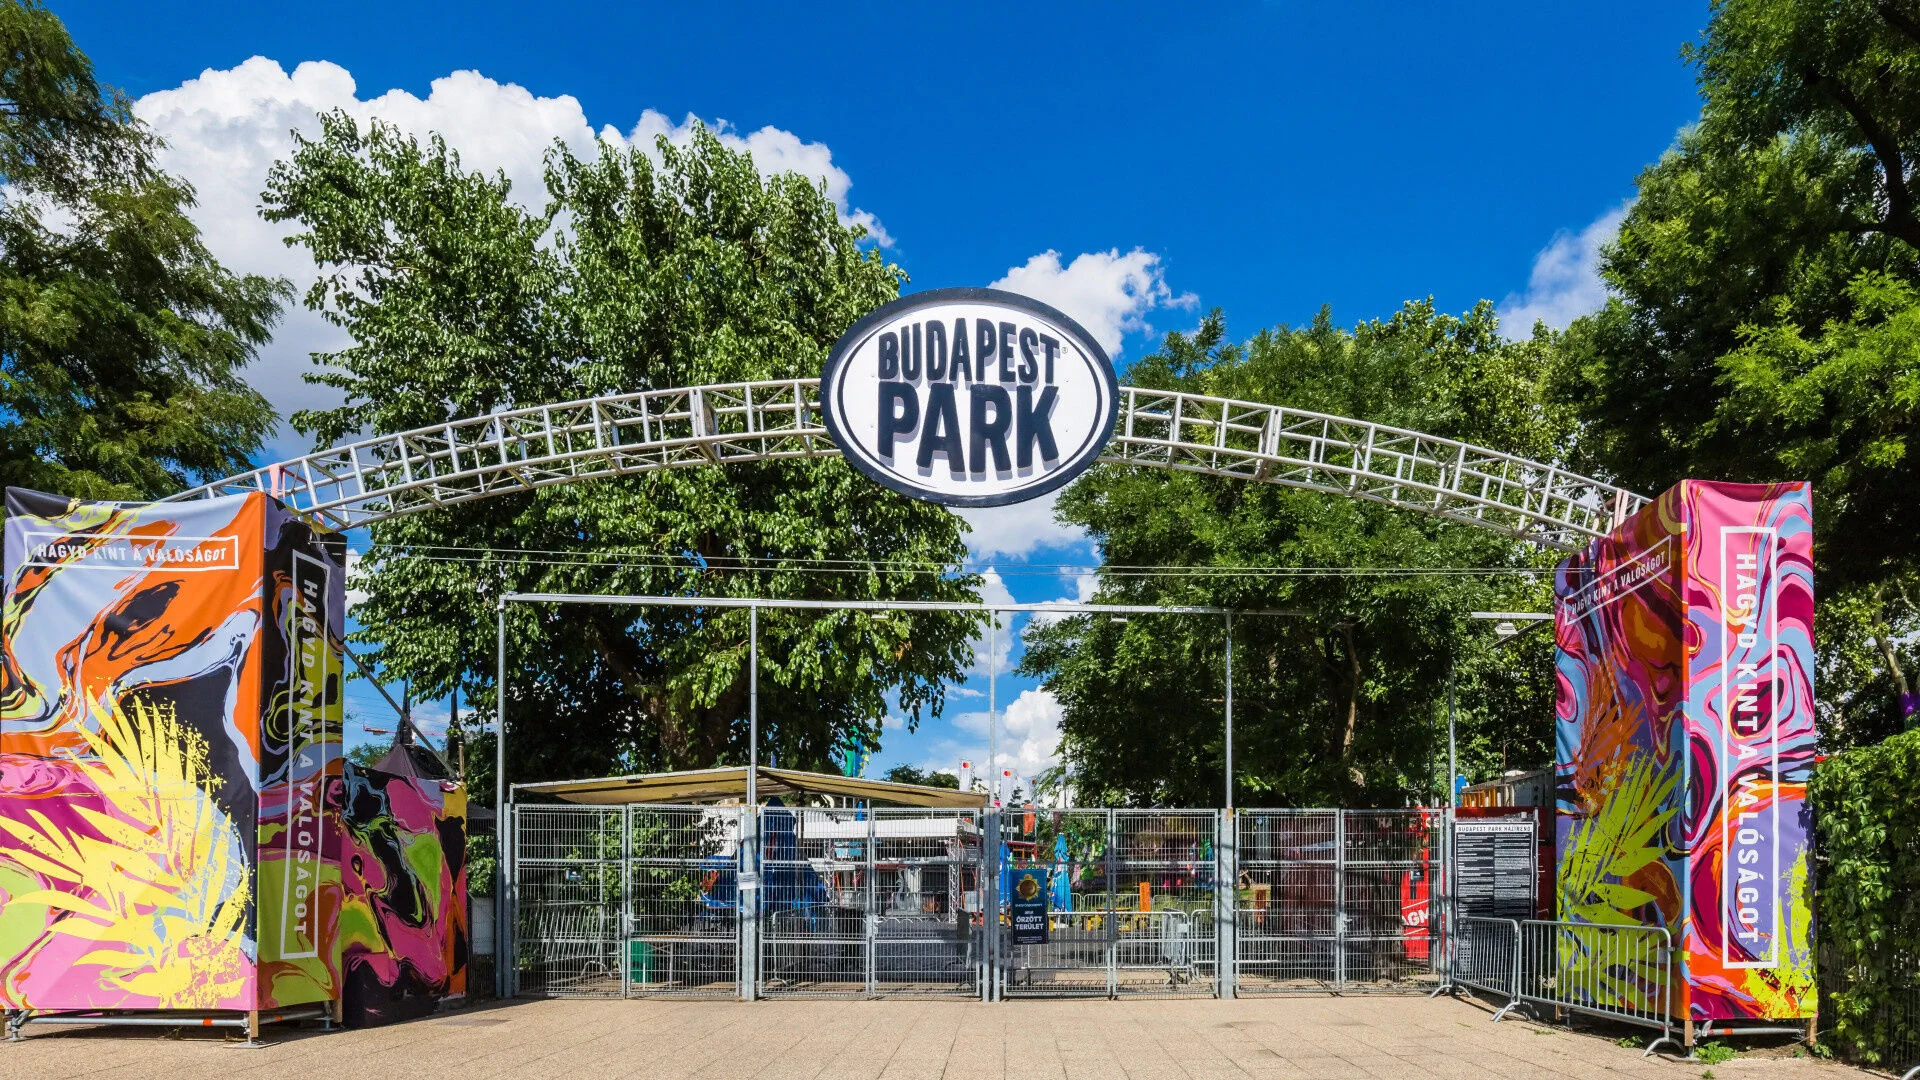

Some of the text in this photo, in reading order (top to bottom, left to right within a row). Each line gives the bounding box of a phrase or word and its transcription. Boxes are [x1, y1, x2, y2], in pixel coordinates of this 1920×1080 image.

[878, 317, 1060, 385] BUDAPEST
[878, 381, 1060, 474] PARK
[37, 544, 87, 559] HAGYD
[93, 547, 126, 561] KINT
[144, 545, 228, 562] VALÓSÁGOT
[1572, 550, 1666, 615] HAGYD KINT A VALÓSÁGOT
[293, 578, 319, 936] HAGYD KINT A VALÓSÁGOT
[1736, 553, 1765, 944] HAGYD KINT A VALÓSÁGOT
